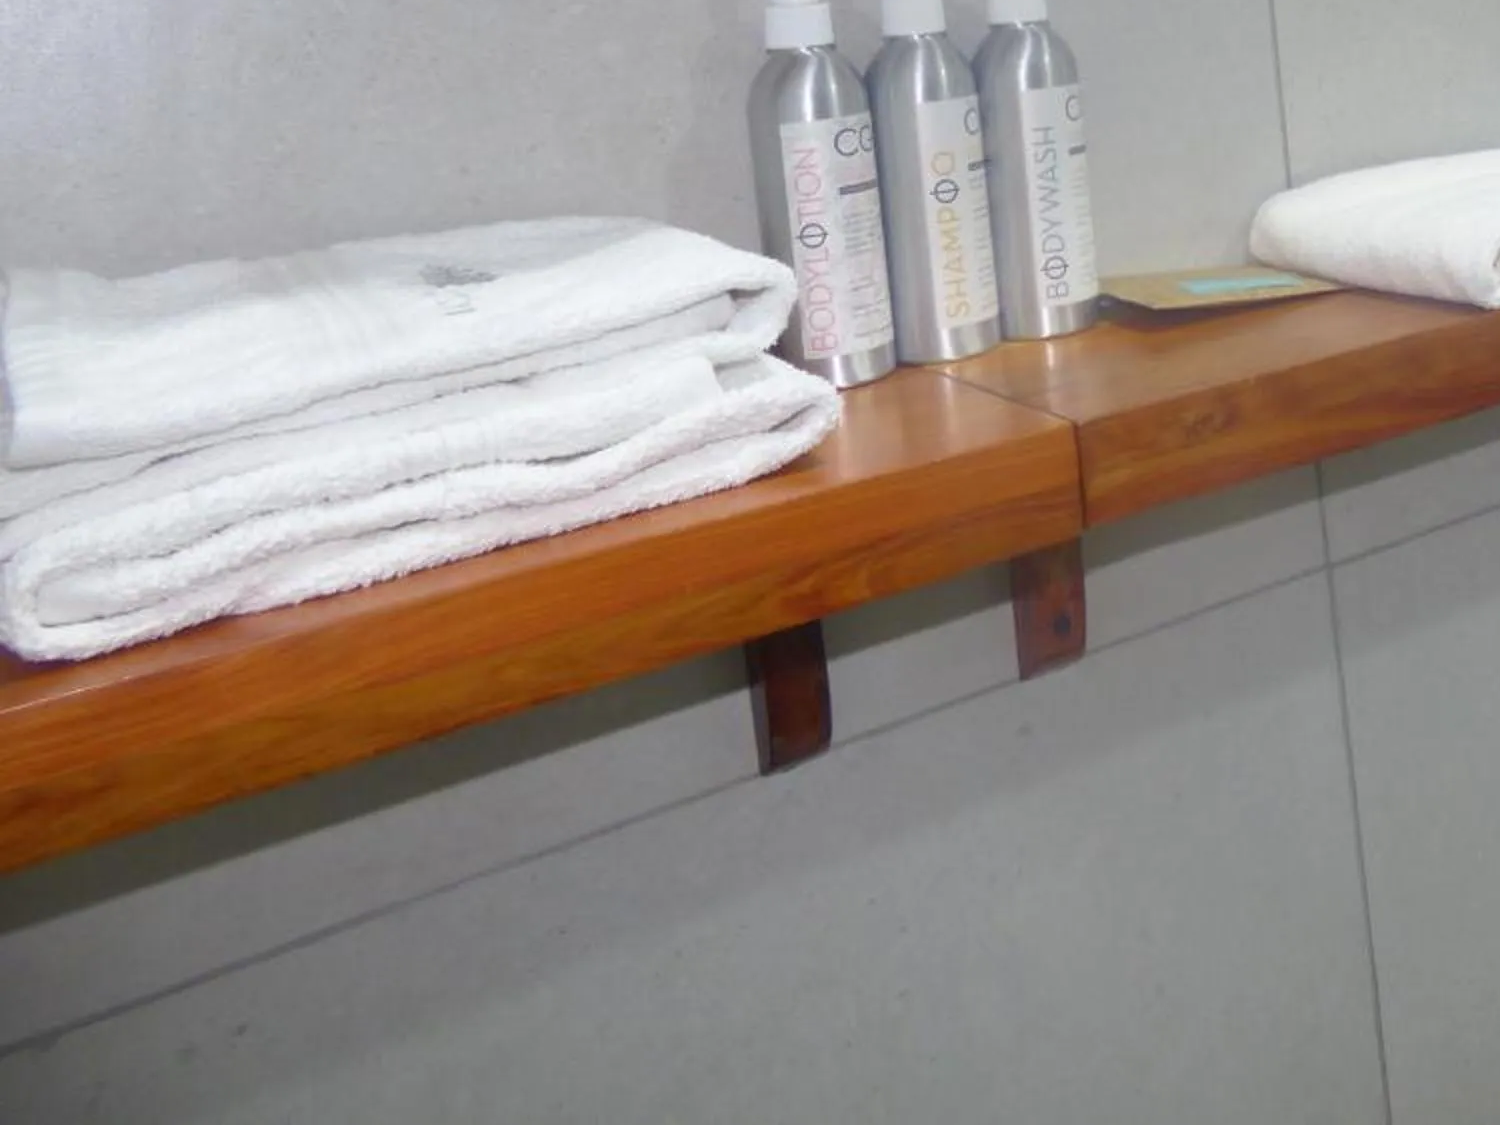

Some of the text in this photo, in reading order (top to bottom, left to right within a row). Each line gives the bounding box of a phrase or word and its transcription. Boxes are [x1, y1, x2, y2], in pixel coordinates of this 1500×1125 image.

[793, 147, 838, 352] BODYLOTION
[929, 151, 971, 318] SHAMPOO
[1032, 126, 1070, 299] BODYWASH
